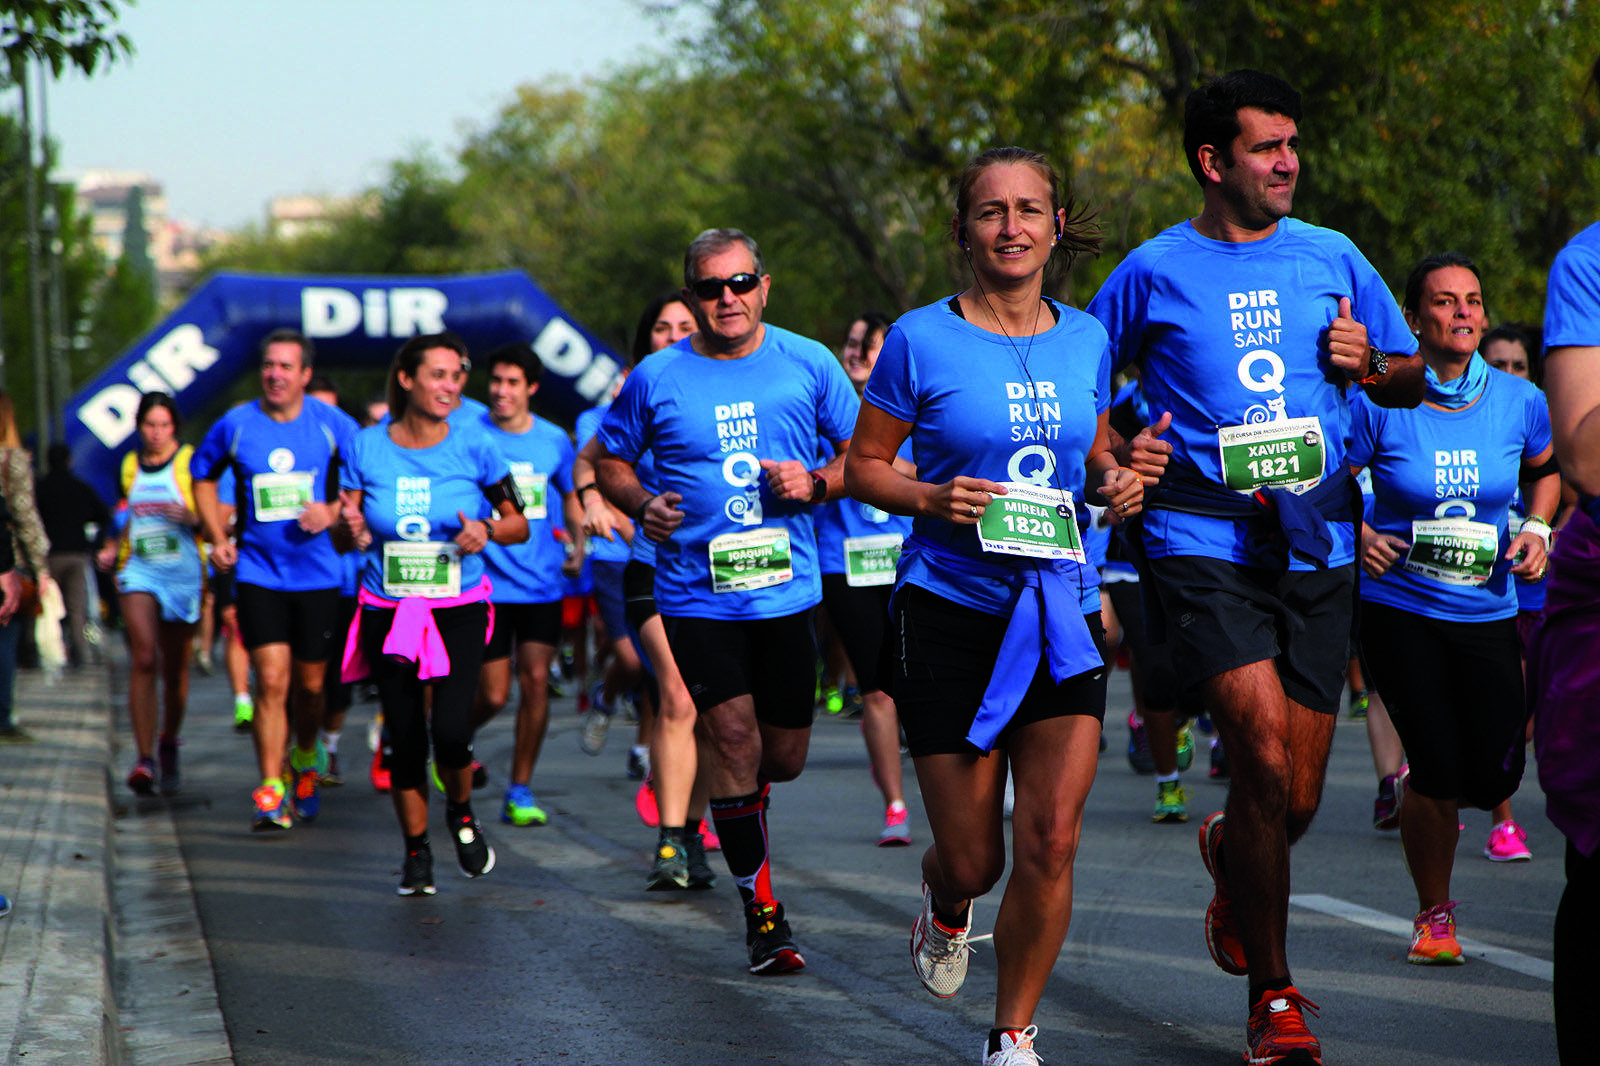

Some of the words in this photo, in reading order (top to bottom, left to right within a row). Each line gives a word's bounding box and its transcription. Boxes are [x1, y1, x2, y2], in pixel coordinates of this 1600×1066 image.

[1228, 290, 1279, 310] DiR
[301, 287, 448, 337] DiR
[1230, 309, 1282, 331] RUN
[1234, 330, 1282, 348] SANT
[1237, 349, 1286, 394] Q
[76, 323, 221, 449] DiR
[1005, 380, 1058, 400] DiR
[714, 401, 756, 421] DiR
[1008, 402, 1062, 423] RUN
[716, 420, 758, 440] RUN
[1010, 424, 1062, 442] SANT
[720, 436, 758, 453] SANT
[1248, 441, 1297, 458] XAVIER
[1008, 444, 1057, 488] Q
[1247, 455, 1300, 479] 1821
[1434, 450, 1478, 466] DiR
[722, 452, 761, 488] Q
[1435, 467, 1480, 485] RUN
[396, 490, 432, 505] RUN
[1435, 484, 1480, 499] SANT
[1004, 501, 1050, 518] MIREIA
[396, 514, 432, 542] Q
[1002, 515, 1056, 538] 1820
[1433, 536, 1479, 550] MONTSE
[728, 546, 773, 562] JOAQUIN
[1432, 548, 1476, 566] 1419
[399, 566, 436, 581] 1727
